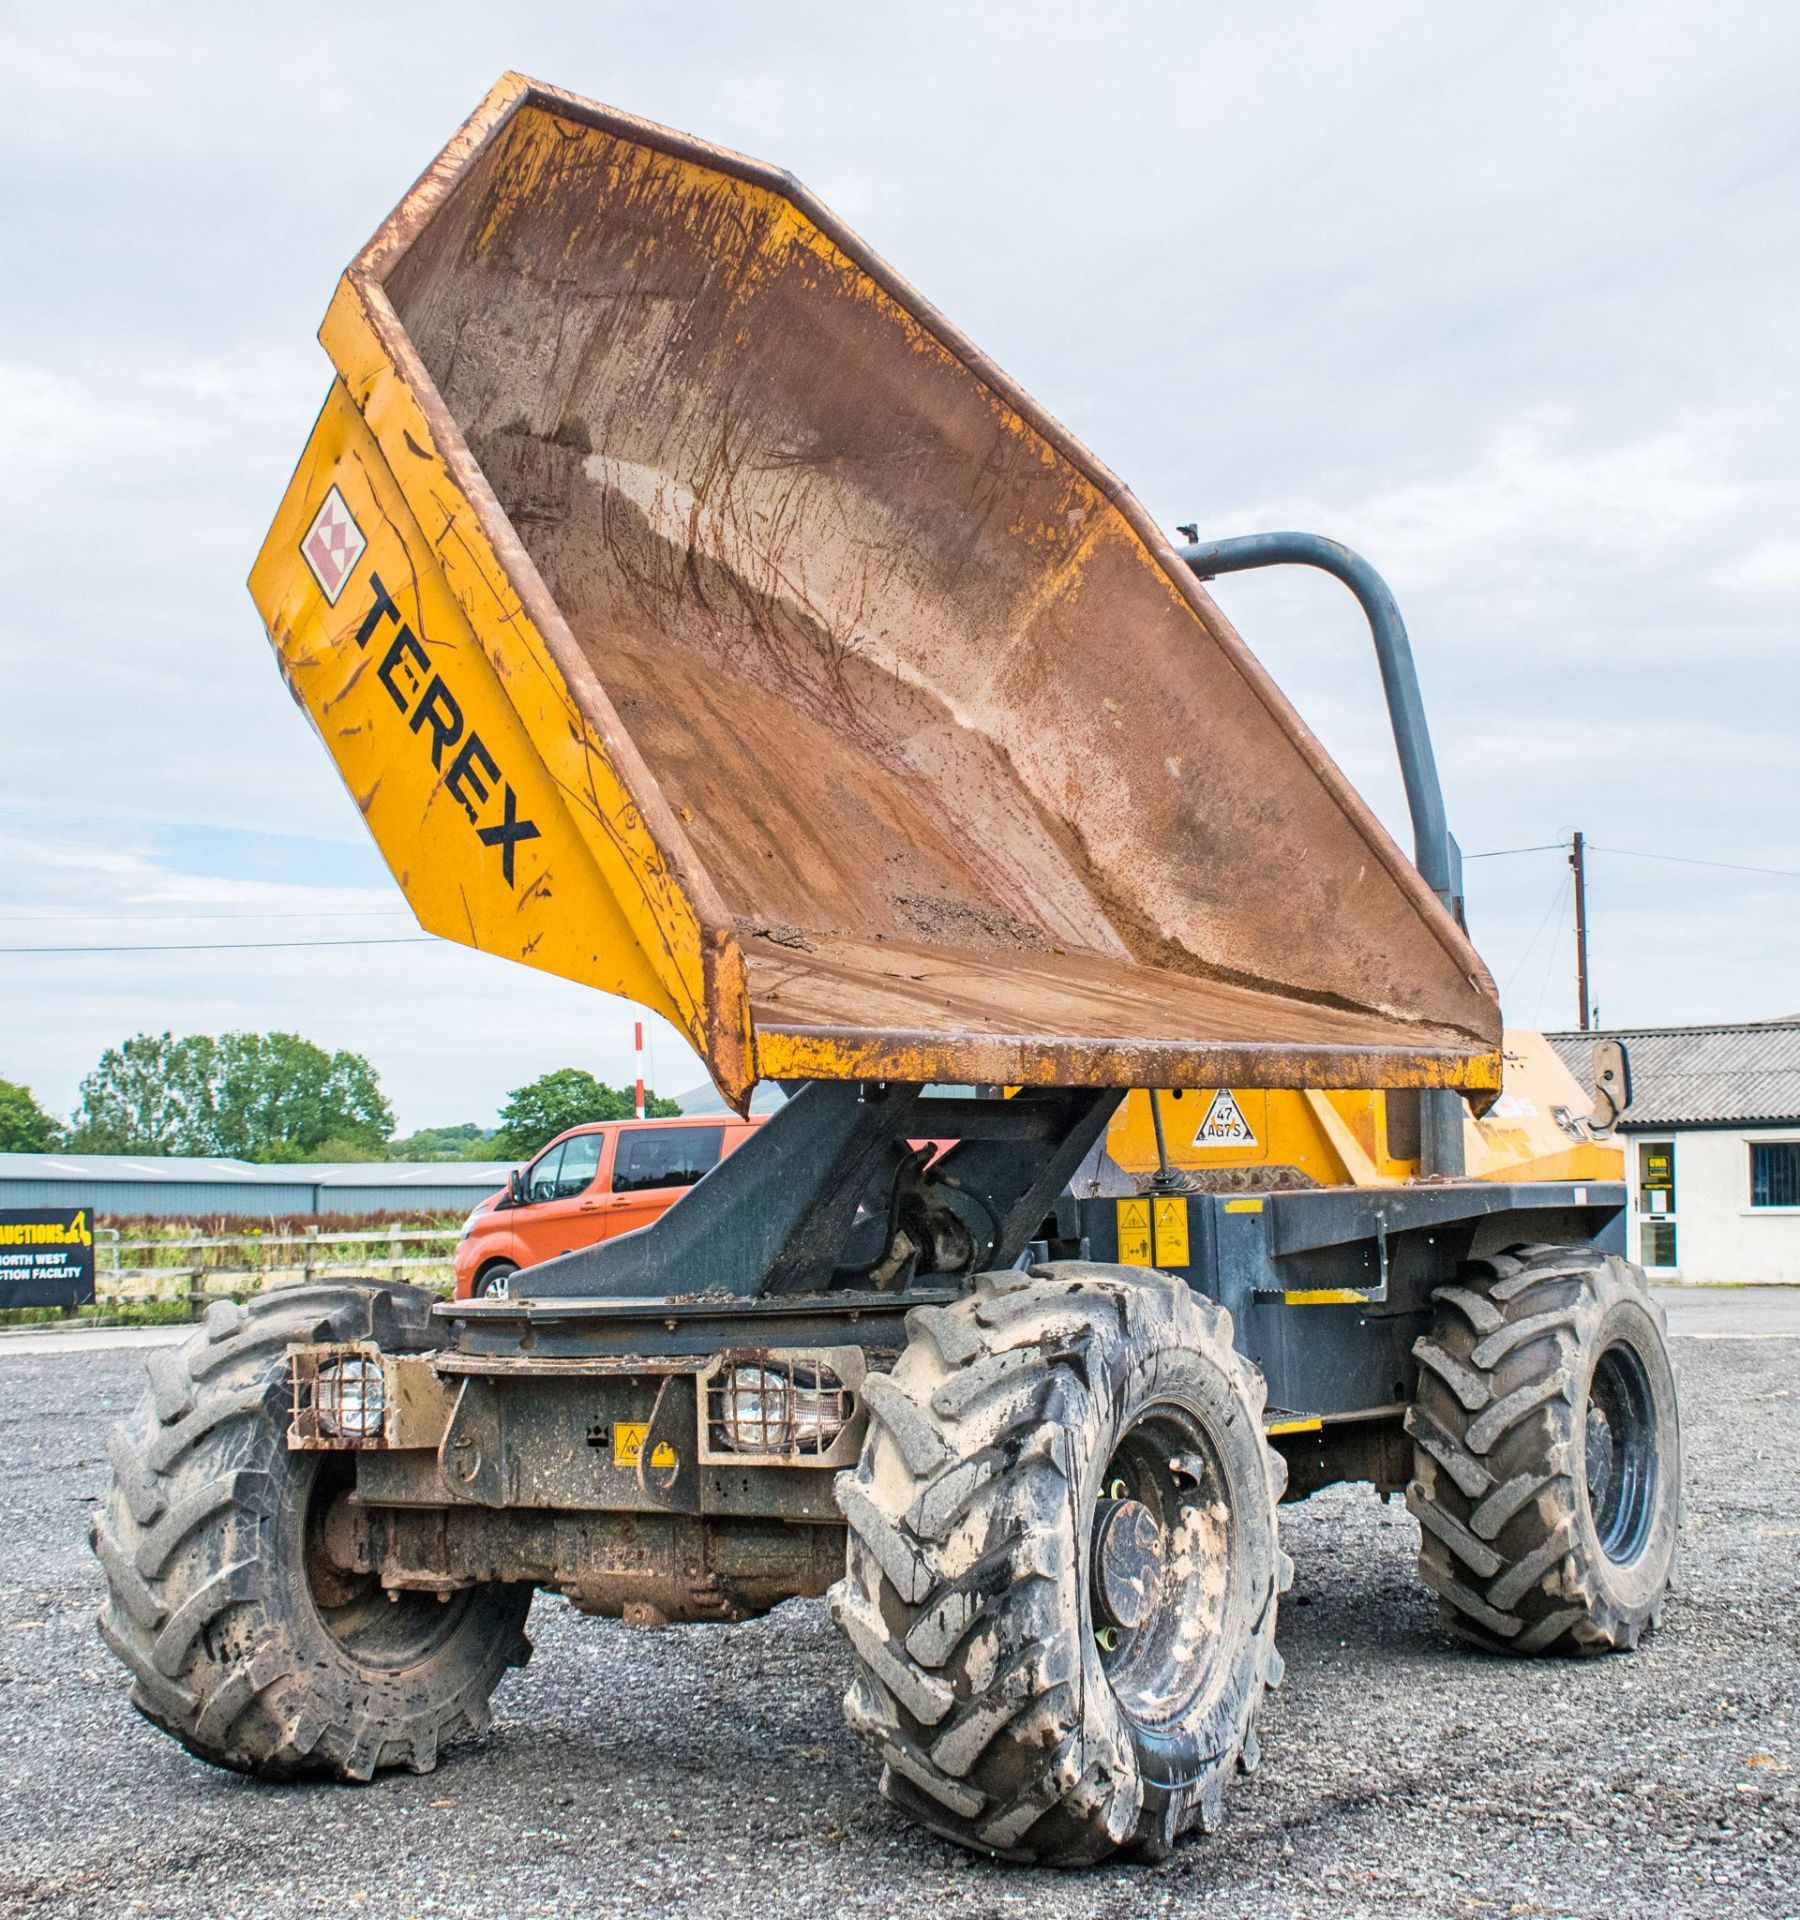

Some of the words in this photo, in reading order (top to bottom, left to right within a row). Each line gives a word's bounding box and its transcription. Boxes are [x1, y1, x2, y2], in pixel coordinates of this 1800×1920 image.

[355, 571, 542, 890] TEREX
[1216, 1107, 1232, 1120] 47
[0, 1254, 34, 1266] ORTH
[35, 1253, 68, 1265] WEST
[32, 1266, 82, 1279] FACILITY
